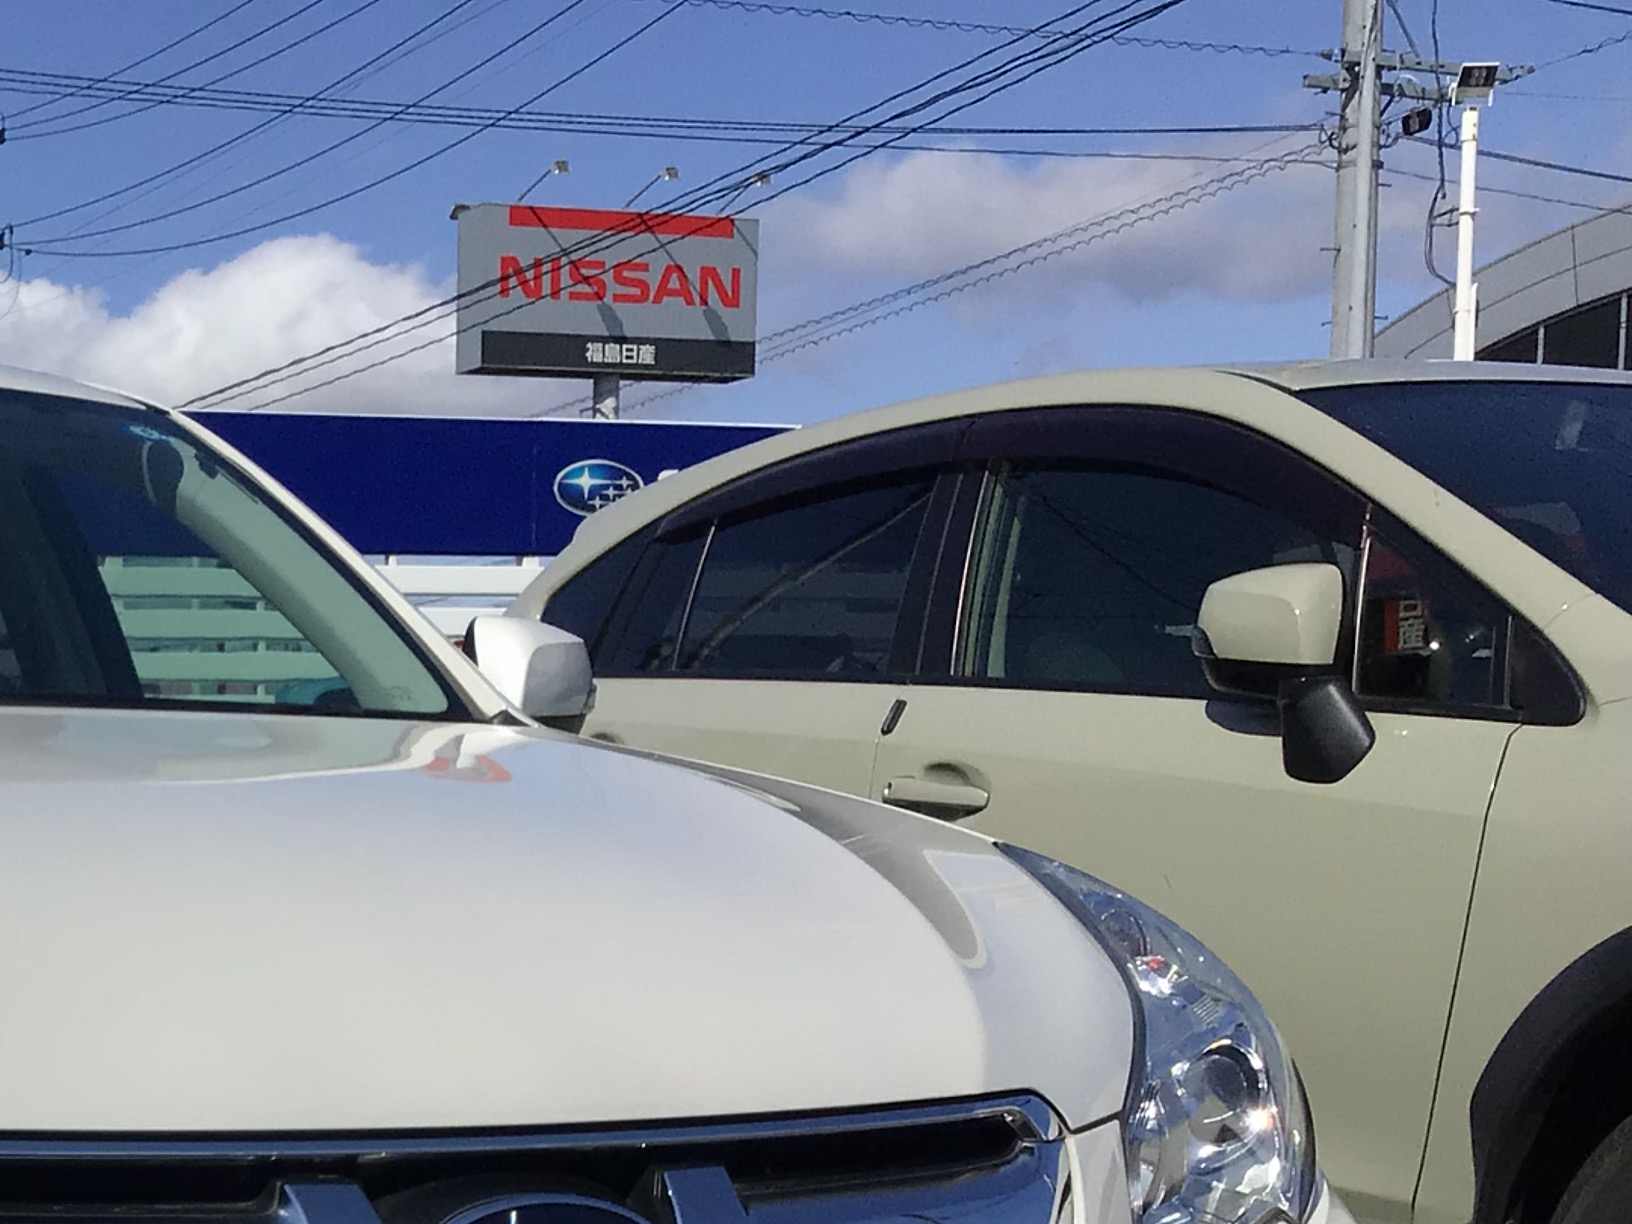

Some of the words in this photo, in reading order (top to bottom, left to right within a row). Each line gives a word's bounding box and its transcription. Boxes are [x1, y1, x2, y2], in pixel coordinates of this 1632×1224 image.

[499, 255, 741, 308] NISSAN
[585, 342, 656, 365] 福島日産
